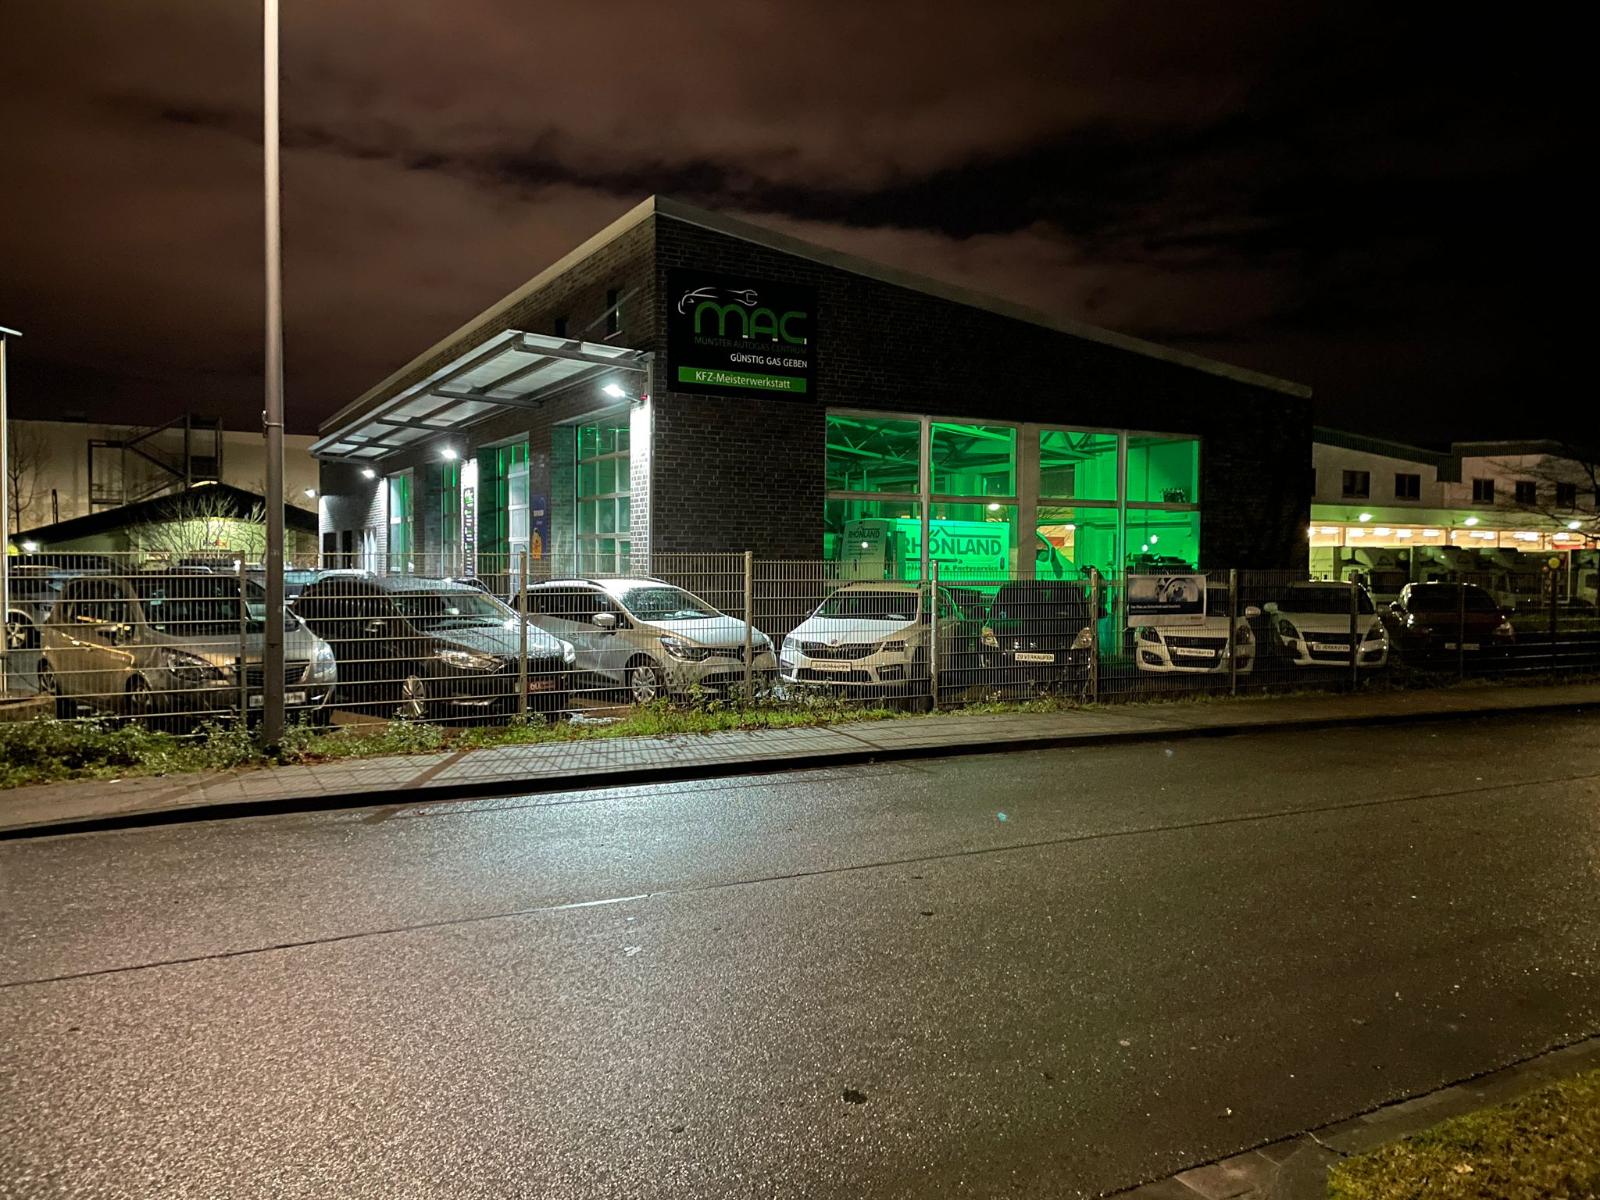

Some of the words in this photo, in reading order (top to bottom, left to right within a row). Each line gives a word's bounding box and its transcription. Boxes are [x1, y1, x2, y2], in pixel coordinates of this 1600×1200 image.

[730, 353, 764, 365] GÜNSTIG
[766, 357, 781, 366] GAS
[783, 358, 807, 368] GEBEN
[695, 371, 790, 389] KFZ-Meisterwerkstatt
